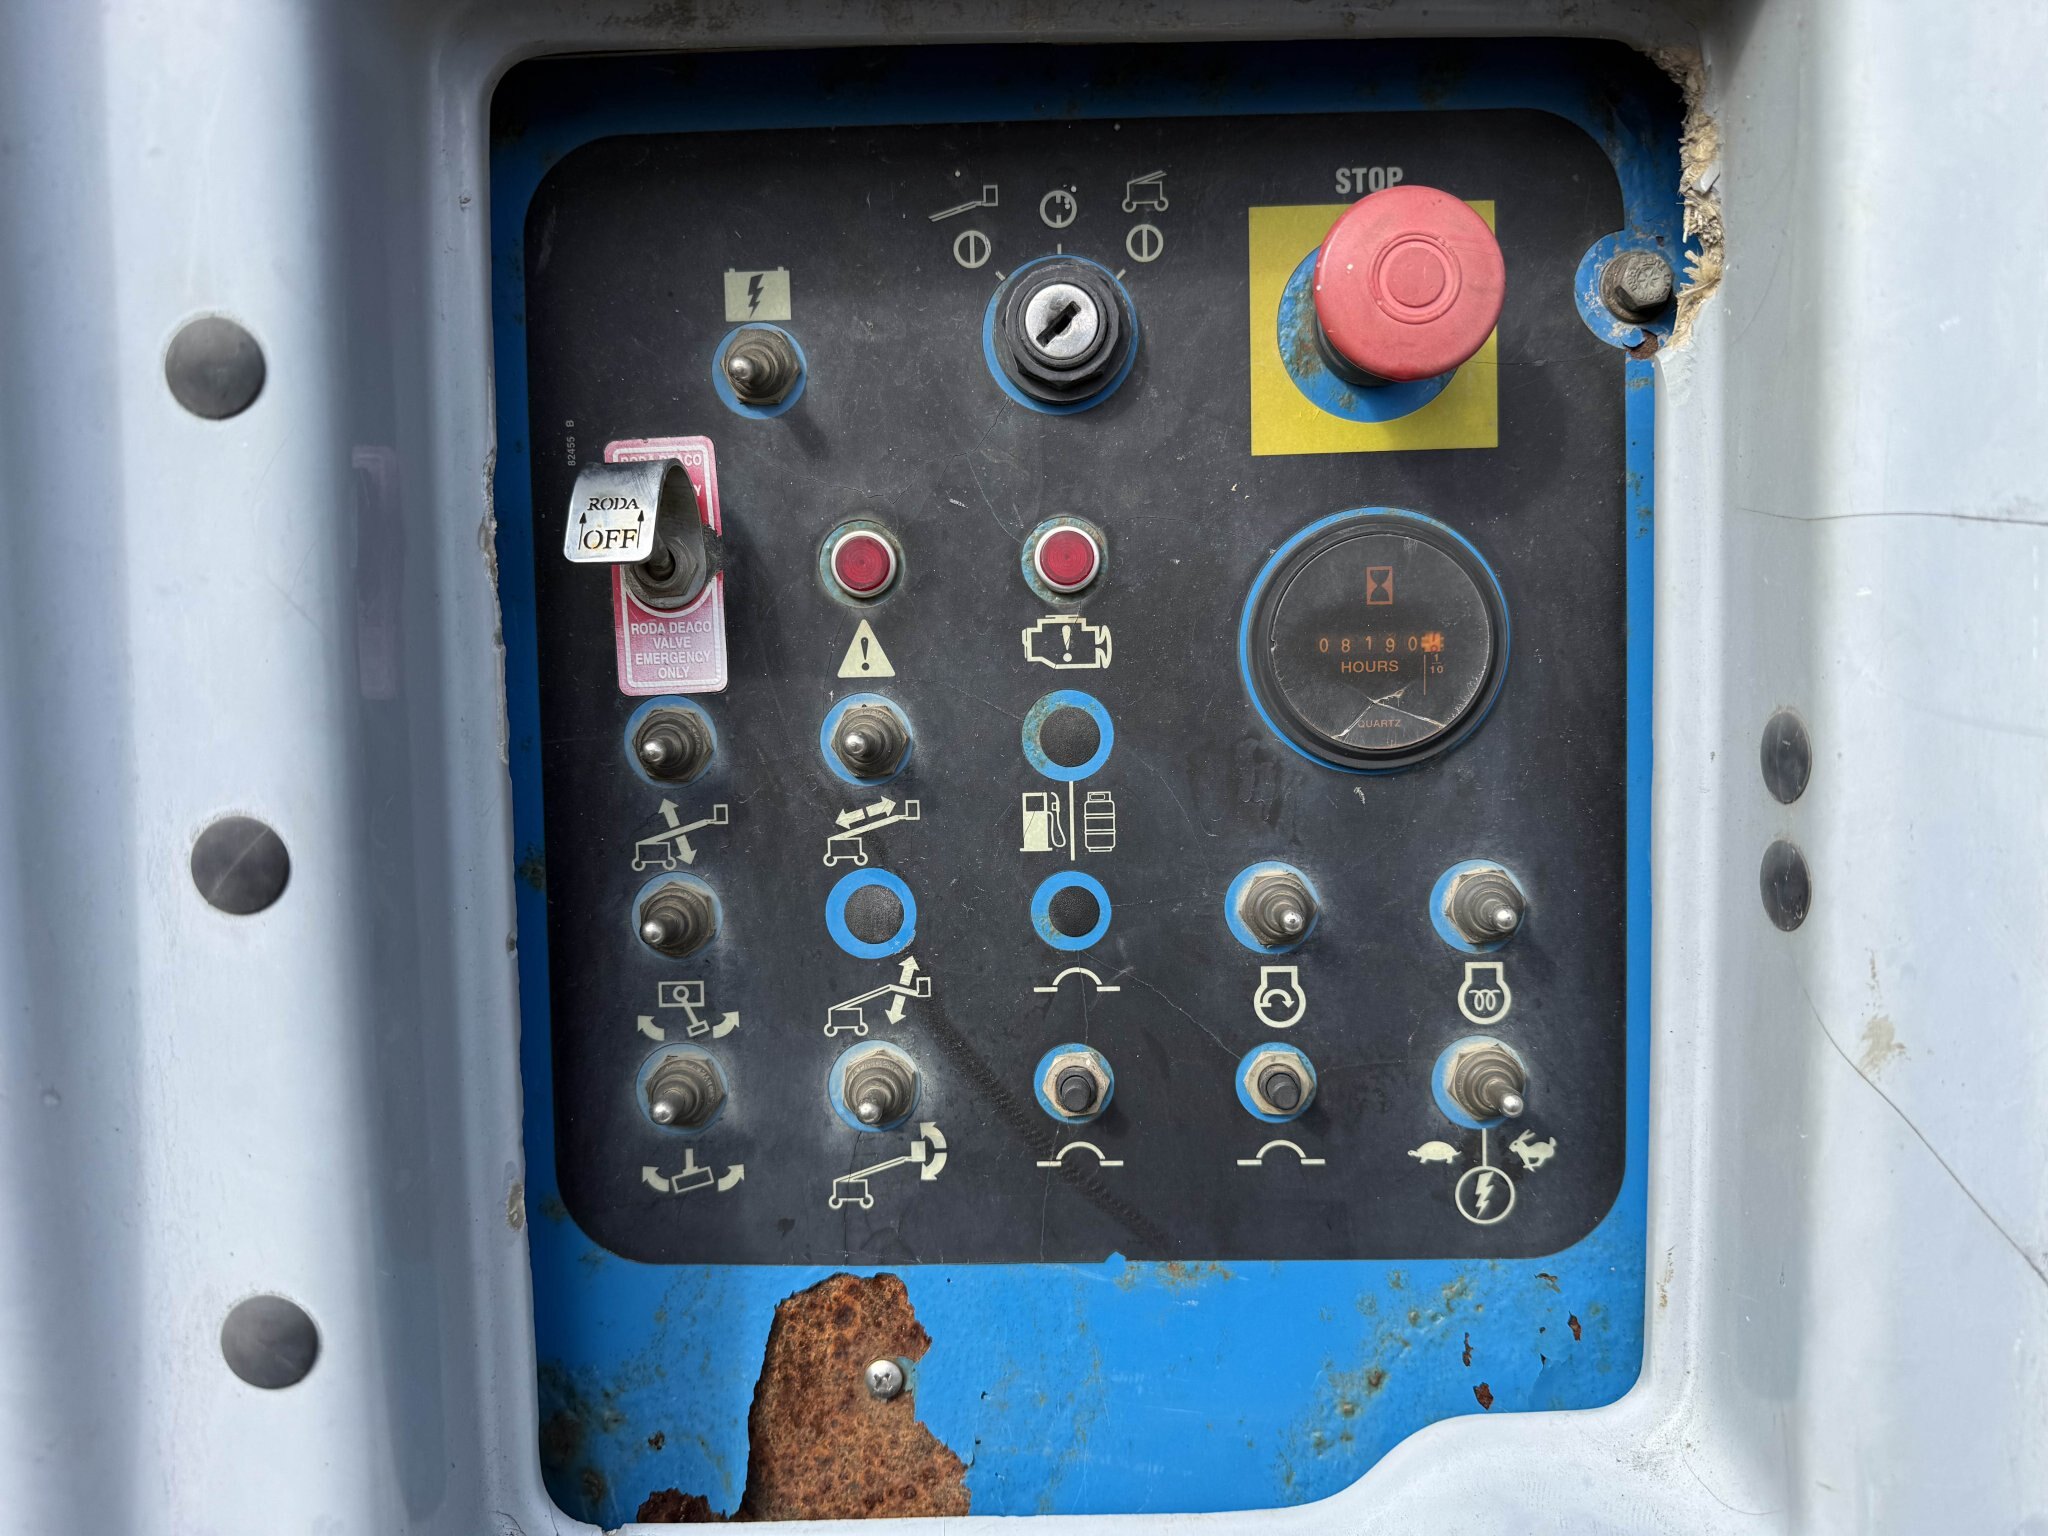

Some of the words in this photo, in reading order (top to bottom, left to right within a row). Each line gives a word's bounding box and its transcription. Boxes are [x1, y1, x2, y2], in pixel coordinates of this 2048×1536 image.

[1335, 166, 1403, 194] STOP
[587, 497, 640, 511] RODA
[583, 529, 637, 550] OFF
[630, 622, 666, 635] RODA
[669, 620, 712, 634] DEACO
[653, 636, 692, 649] VALVE
[635, 650, 711, 665] EMERGENCY
[658, 666, 690, 678] ONLY
[1341, 660, 1399, 673] HOURS
[1358, 719, 1401, 728] QUARTZ
